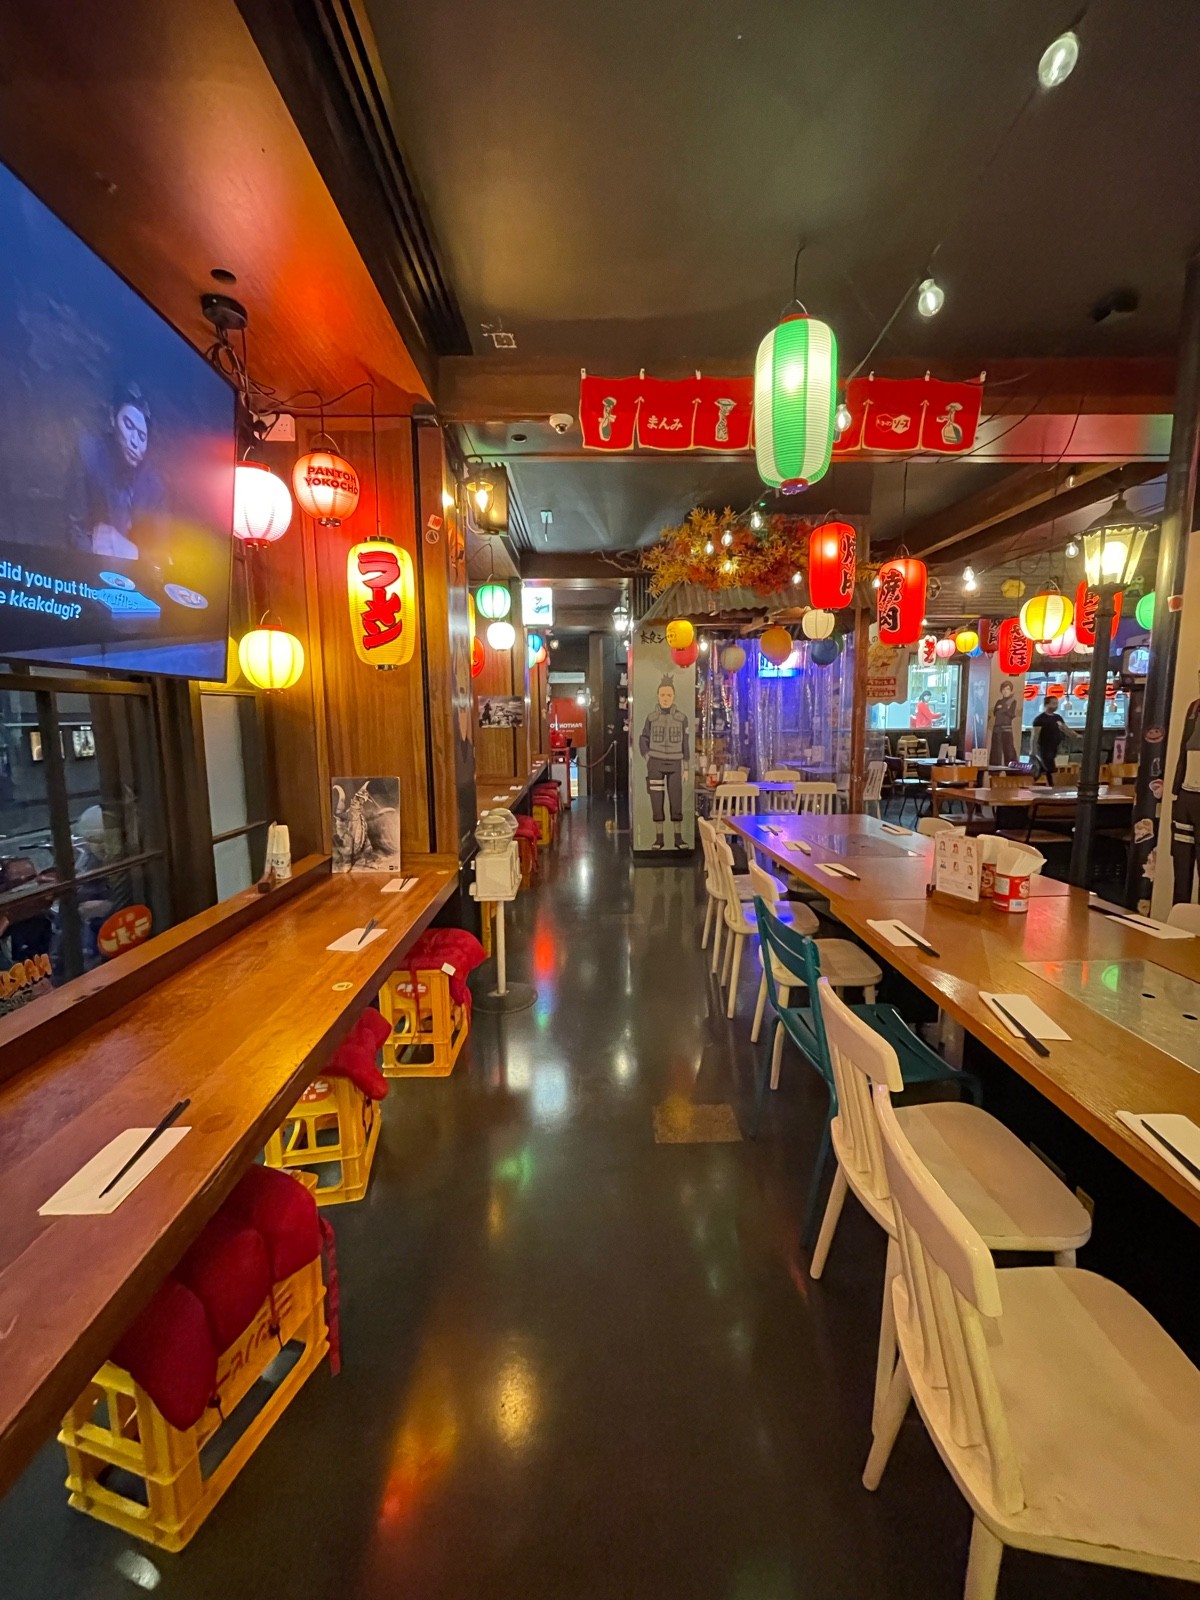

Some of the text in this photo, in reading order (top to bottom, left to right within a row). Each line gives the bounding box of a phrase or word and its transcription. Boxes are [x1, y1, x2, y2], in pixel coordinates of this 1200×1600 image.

[304, 476, 359, 495] YOKOCHO
[25, 571, 51, 589] you
[55, 579, 77, 595] put
[79, 583, 98, 600] the
[358, 550, 403, 650] ラーメン
[9, 589, 82, 620] kkakdugi?
